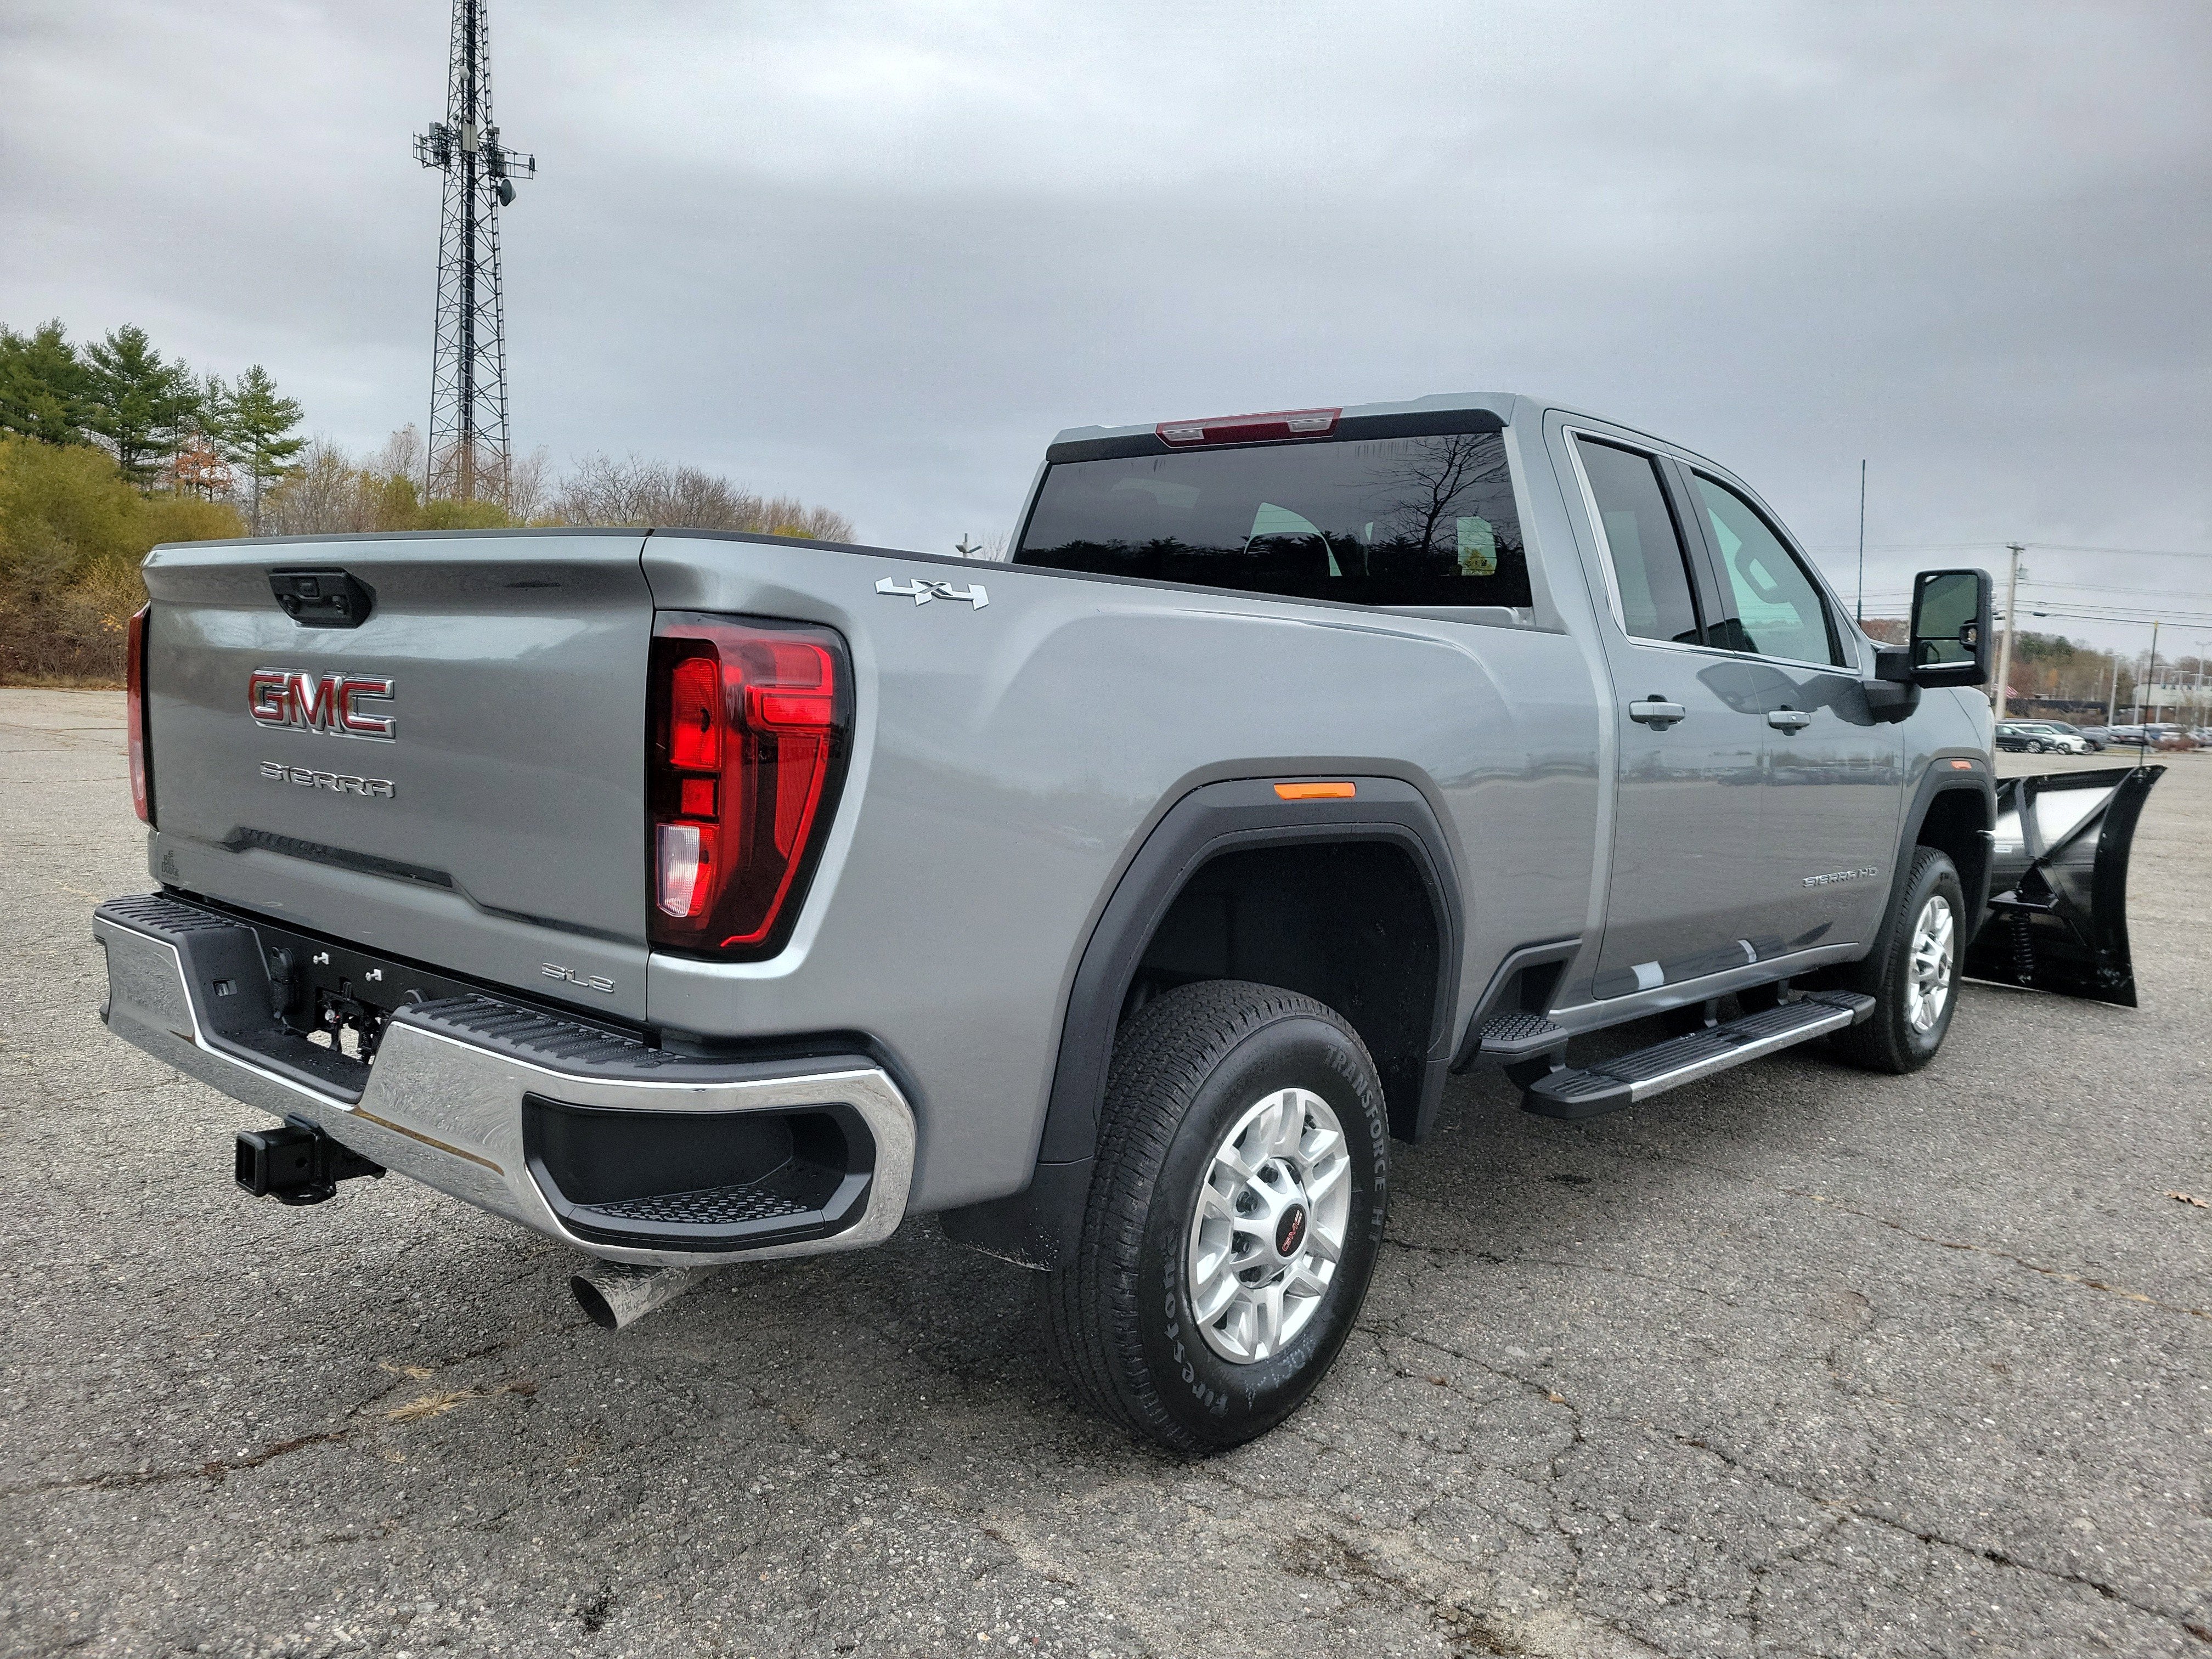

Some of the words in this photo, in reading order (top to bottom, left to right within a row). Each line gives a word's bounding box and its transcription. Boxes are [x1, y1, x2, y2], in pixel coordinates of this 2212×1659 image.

[249, 668, 396, 742] GMC
[260, 761, 394, 798] SIERRA
[1802, 870, 1857, 888] SIERRA
[1857, 867, 1877, 879] HD
[541, 963, 615, 994] SLE
[1324, 1042, 1386, 1192] TRANSFORCE
[1282, 1209, 1303, 1251] GMC
[1163, 1228, 1229, 1417] Firestone
